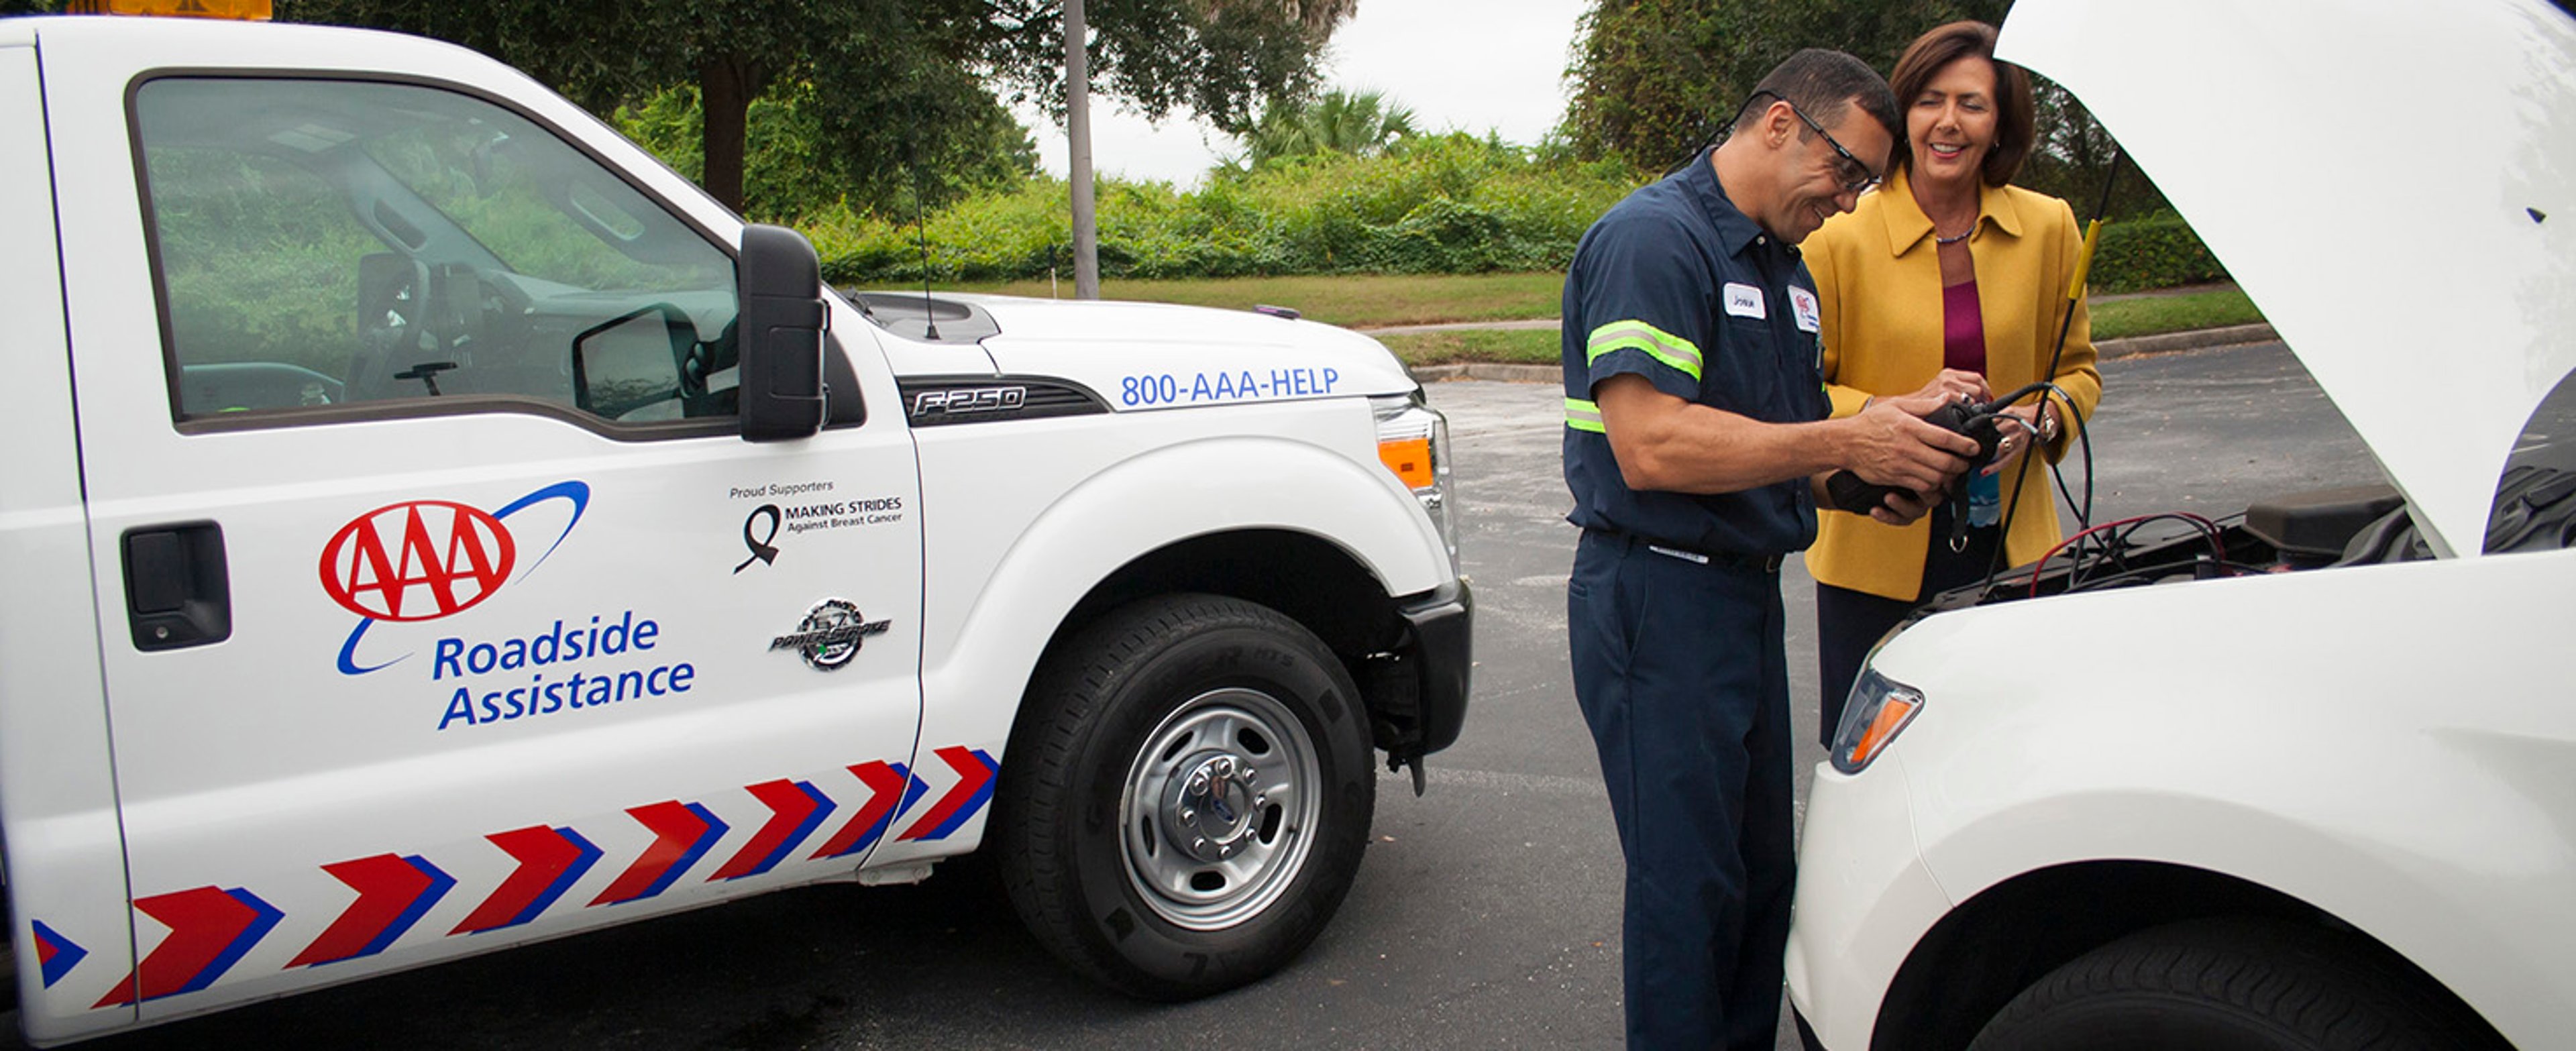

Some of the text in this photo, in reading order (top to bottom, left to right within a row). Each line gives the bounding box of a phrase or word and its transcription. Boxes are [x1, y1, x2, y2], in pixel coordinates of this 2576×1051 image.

[1122, 368, 1339, 406] 800-AAA-HELP
[730, 481, 834, 498] Proud Supporters
[786, 496, 902, 520] MAKING STRIDES
[787, 512, 903, 535] Against Breast Cancer
[334, 502, 504, 618] AAA
[432, 610, 659, 681] Roadside
[437, 661, 696, 731] Assistance
